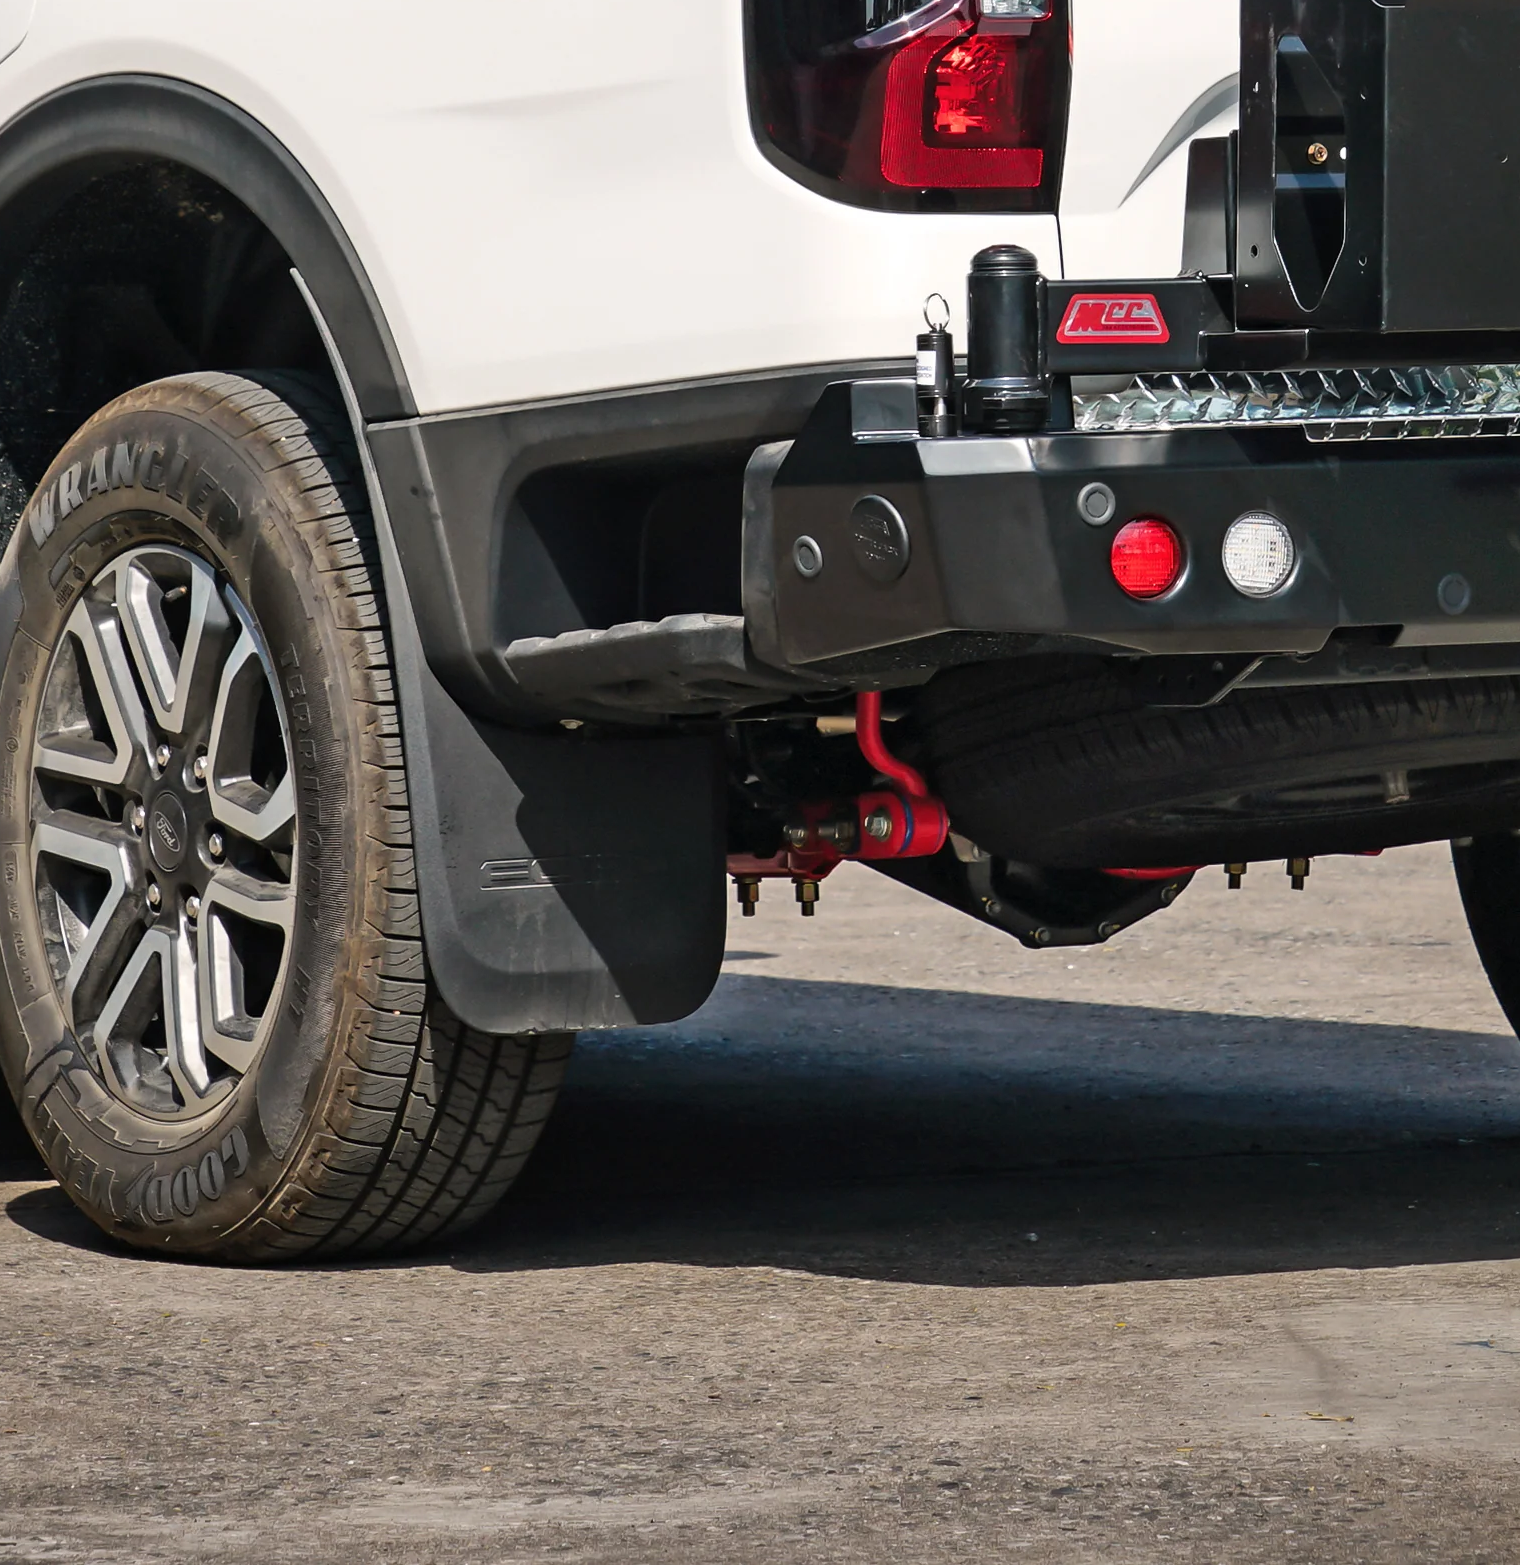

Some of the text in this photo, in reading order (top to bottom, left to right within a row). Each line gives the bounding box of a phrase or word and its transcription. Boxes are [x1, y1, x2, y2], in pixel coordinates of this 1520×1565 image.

[1067, 301, 1155, 332] MCC
[29, 437, 241, 551] WRANGLER
[281, 642, 323, 932] TERRITORY
[156, 816, 177, 847] Ford
